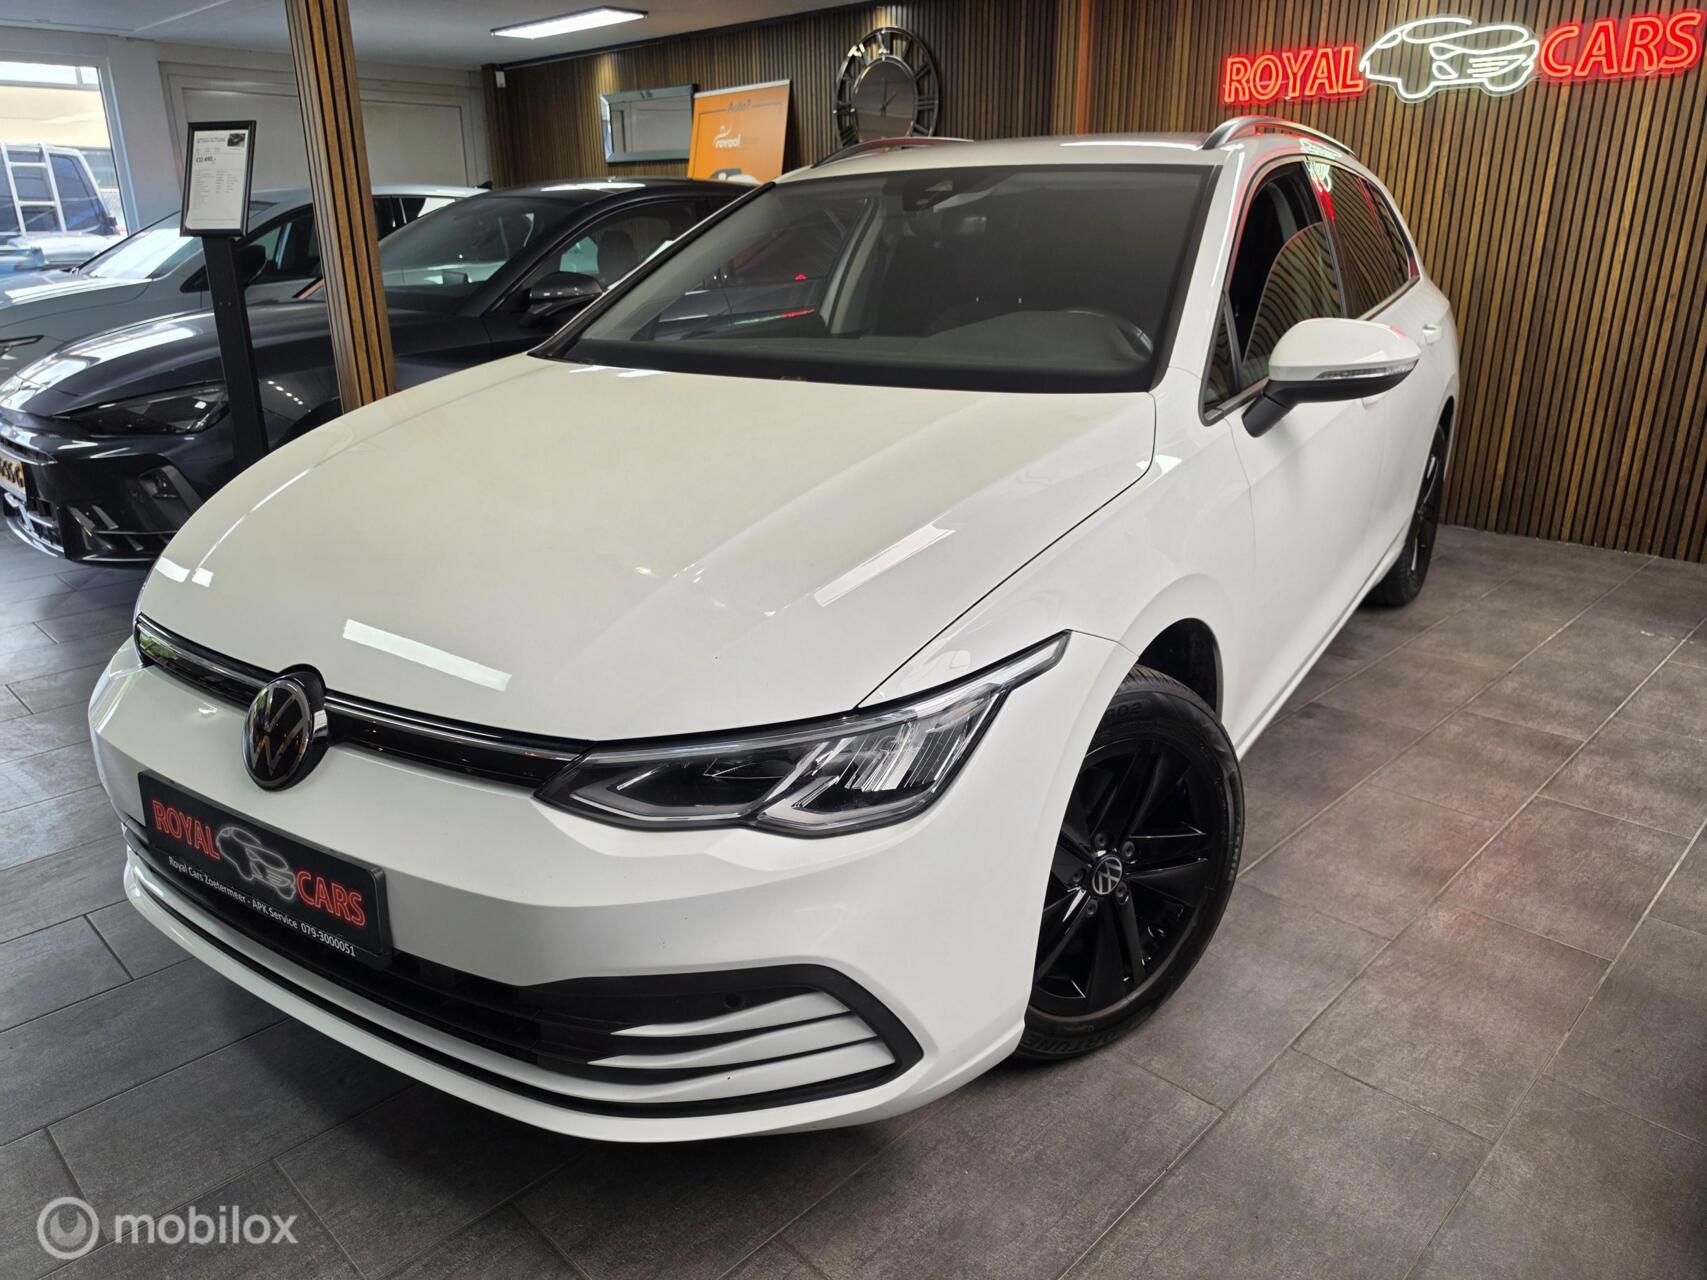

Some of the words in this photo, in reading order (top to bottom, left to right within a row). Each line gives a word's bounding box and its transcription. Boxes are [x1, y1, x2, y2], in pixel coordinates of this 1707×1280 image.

[1224, 46, 1364, 103] ROYAL
[1541, 12, 1704, 77] CARS
[152, 800, 221, 860] ROYAL
[169, 856, 188, 875] Royal
[188, 866, 204, 882] Cars
[204, 873, 247, 902] Zoetermeer
[252, 900, 268, 915] APK
[268, 906, 298, 929] Service
[301, 924, 356, 957] 079-3000051
[296, 870, 366, 927] CARS
